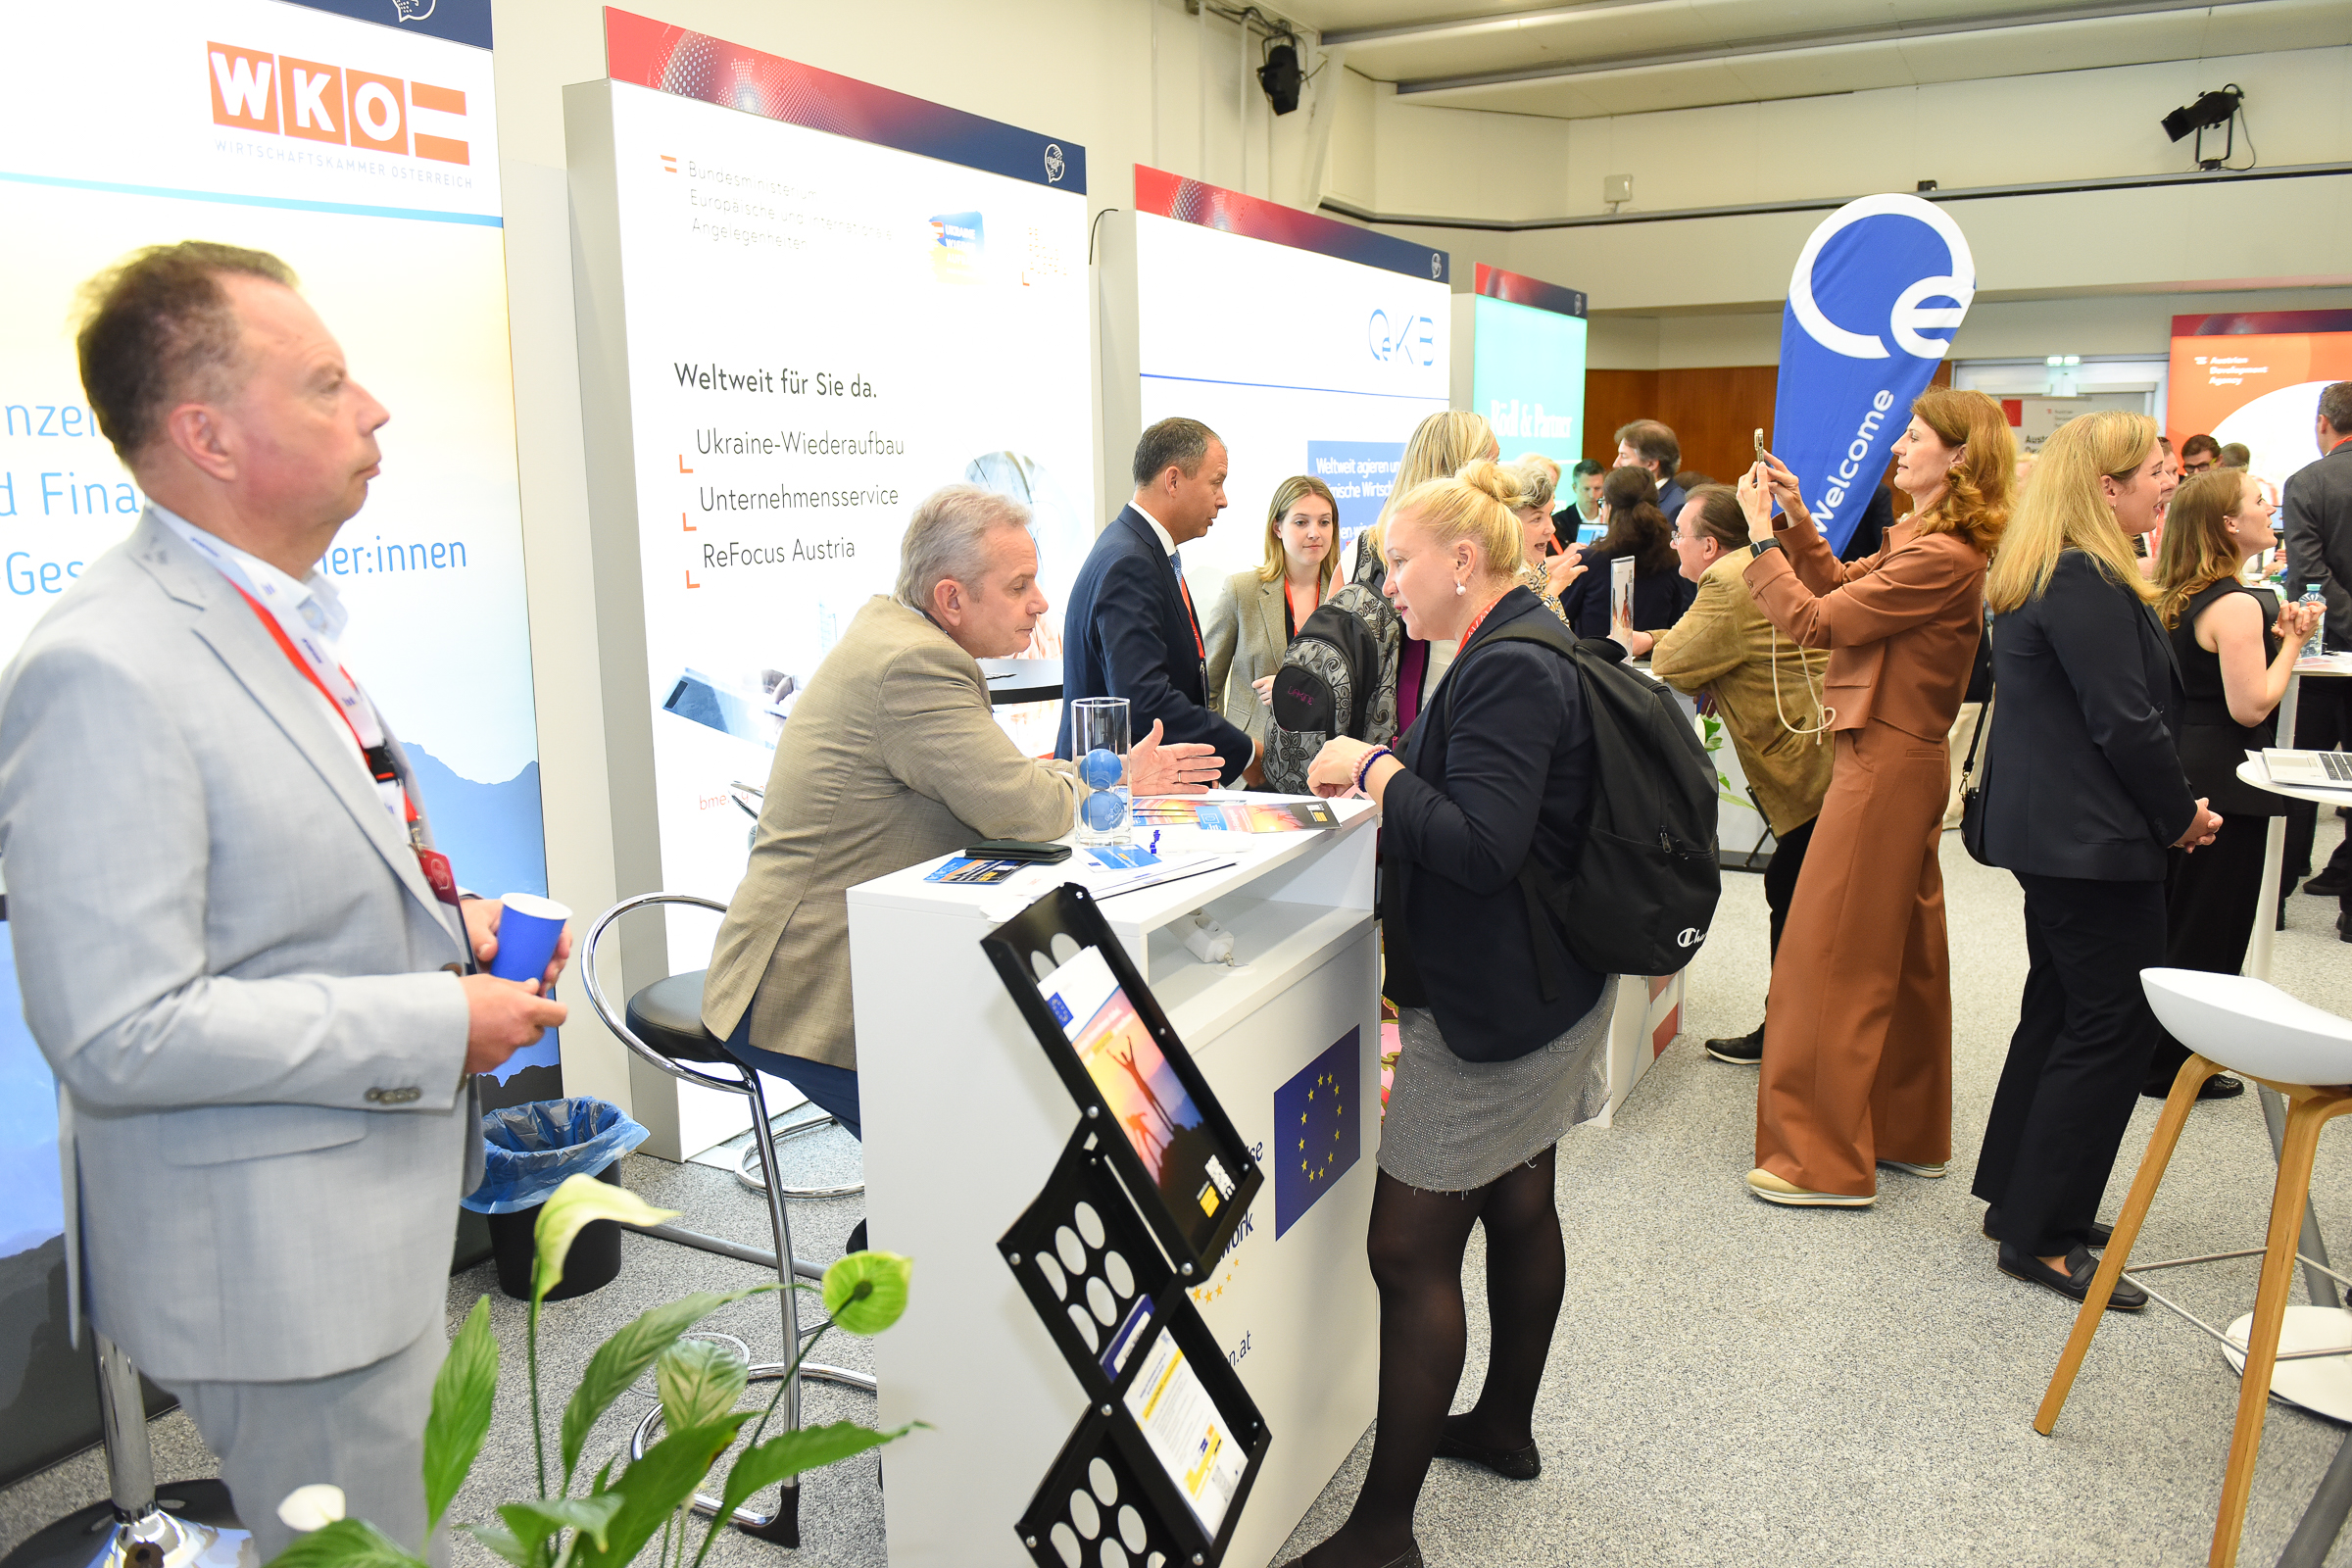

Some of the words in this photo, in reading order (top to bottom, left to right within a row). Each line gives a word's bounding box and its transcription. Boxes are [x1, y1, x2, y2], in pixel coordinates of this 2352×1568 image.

[210, 51, 402, 142] WKO
[214, 138, 386, 176] WIRTSCHAFTSKAMMER
[688, 160, 819, 202] Bundesministerium
[690, 188, 775, 220] Europäische
[692, 218, 808, 251] Angelegenheiten
[673, 362, 774, 394] Weltweit
[780, 368, 808, 395] für
[815, 371, 845, 397] Sie
[850, 373, 878, 399] da.
[1490, 399, 1520, 438] Rödl
[1520, 403, 1534, 438] &
[1534, 403, 1574, 439] Partner
[696, 427, 905, 456] Ukraine-Wiederaufbau
[1315, 456, 1356, 475] Weltweit
[1356, 458, 1390, 479] agieren
[1810, 389, 1895, 535] Welcome
[699, 483, 900, 513] Unternehmensservice
[703, 541, 785, 568] ReFocus
[791, 536, 856, 563] Austria
